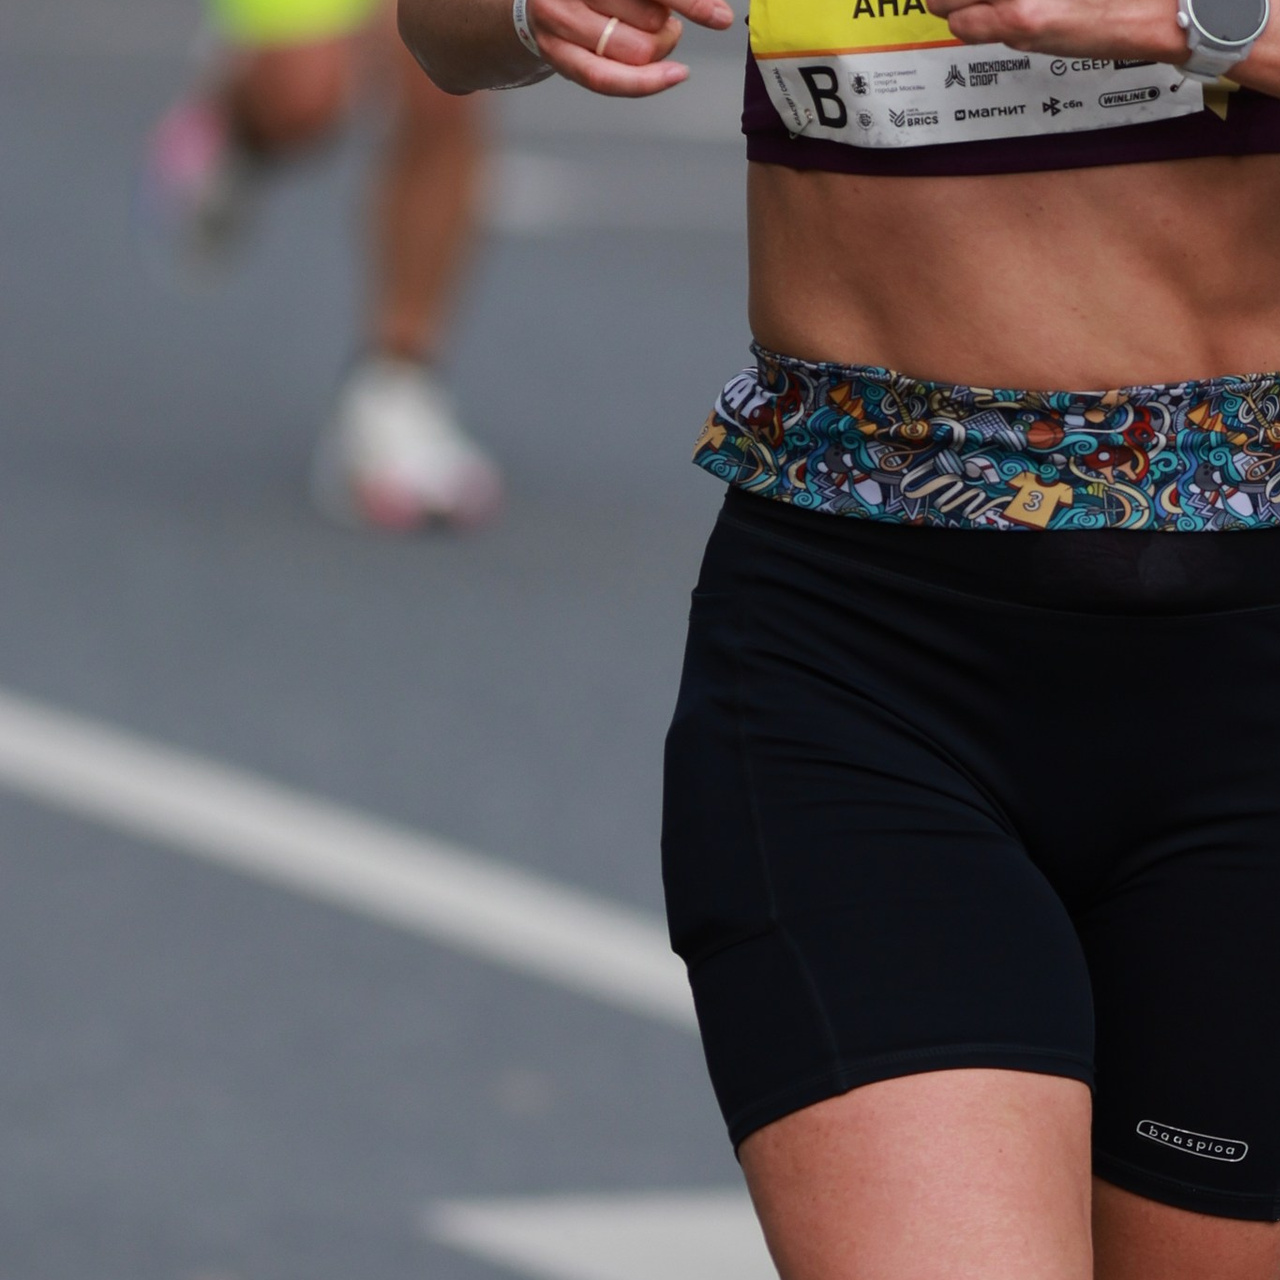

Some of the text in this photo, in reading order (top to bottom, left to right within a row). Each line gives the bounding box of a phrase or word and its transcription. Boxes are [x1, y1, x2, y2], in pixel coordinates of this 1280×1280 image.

[968, 56, 1031, 74] МОСКОВСКИЙ
[1071, 59, 1110, 71] СБЕР
[969, 73, 998, 87] СПОРТ
[1063, 99, 1083, 109] сбп
[1103, 90, 1147, 105] WINLINE
[907, 115, 939, 127] BRICS
[1023, 490, 1044, 512] 3
[1149, 1125, 1235, 1155] baasploa
